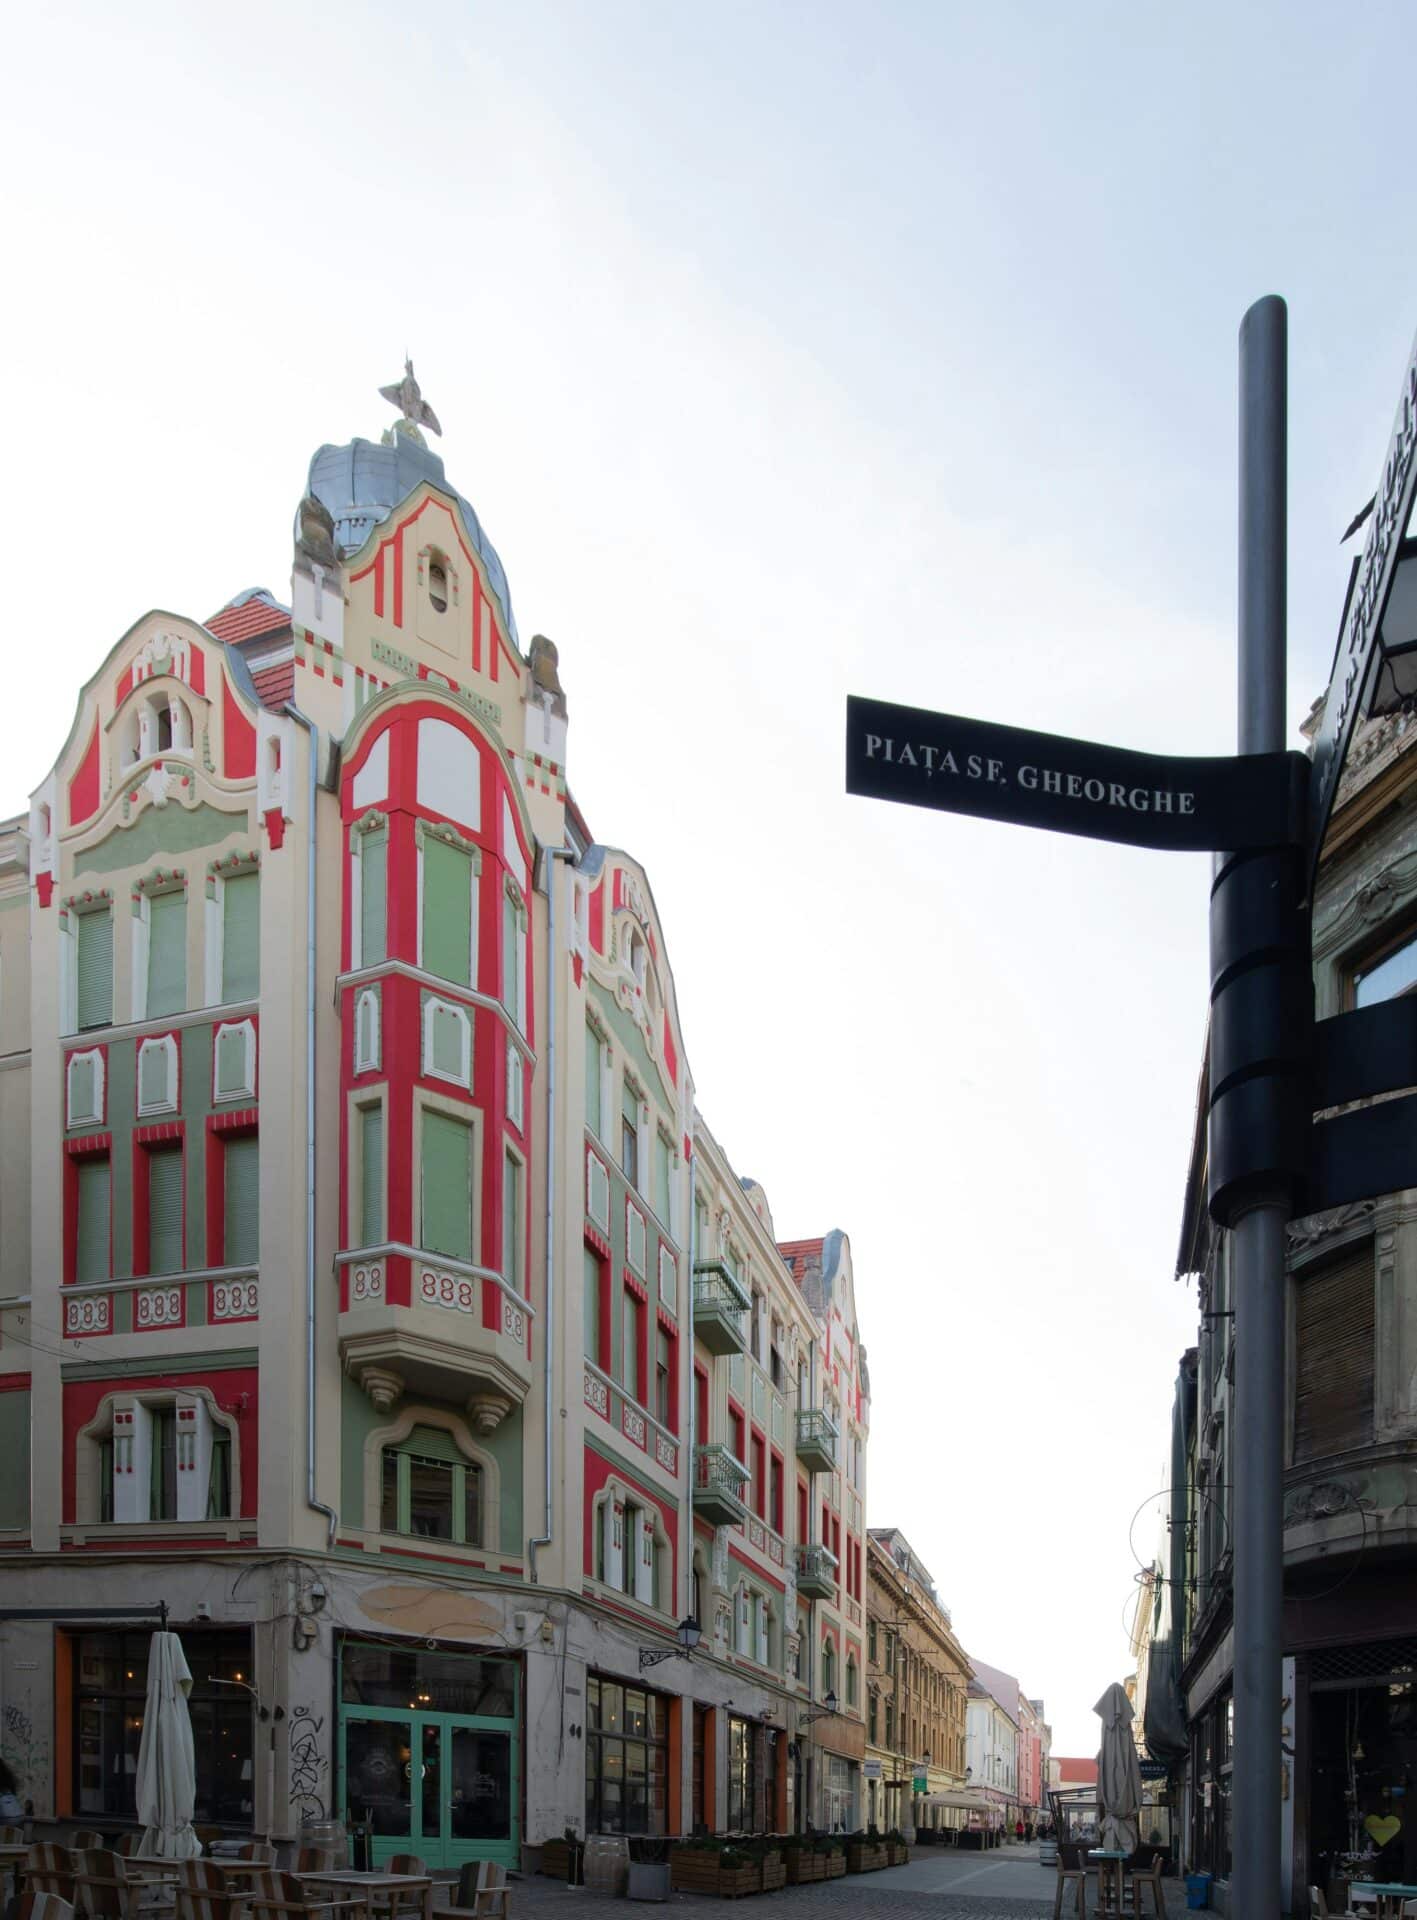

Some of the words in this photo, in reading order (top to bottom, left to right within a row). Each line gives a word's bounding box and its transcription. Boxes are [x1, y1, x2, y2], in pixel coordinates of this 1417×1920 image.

[865, 734, 960, 777] PIAȚA
[967, 754, 1007, 784] SF.
[1017, 765, 1196, 815] GHEORGHE
